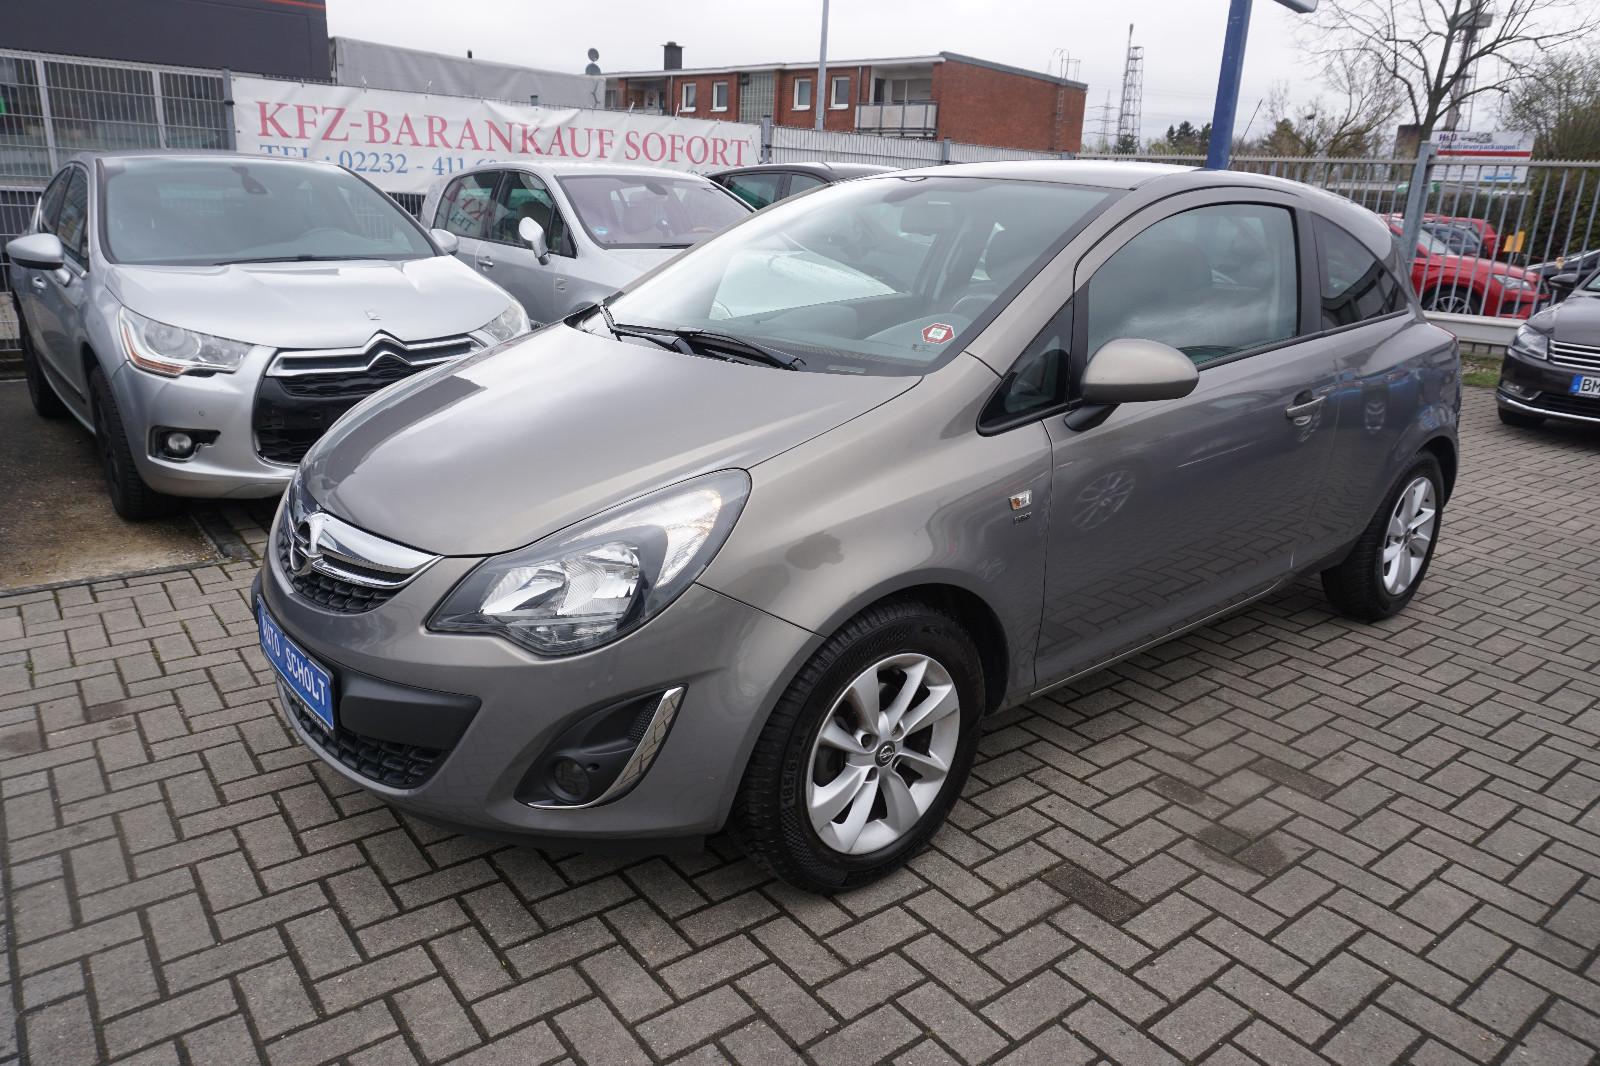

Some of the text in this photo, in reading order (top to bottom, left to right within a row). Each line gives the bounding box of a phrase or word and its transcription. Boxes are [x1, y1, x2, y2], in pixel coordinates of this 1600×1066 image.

[255, 101, 749, 167] KFZ-BARANKAUF SOFORT
[338, 150, 409, 174] 02232
[286, 647, 326, 706] SCHOLT
